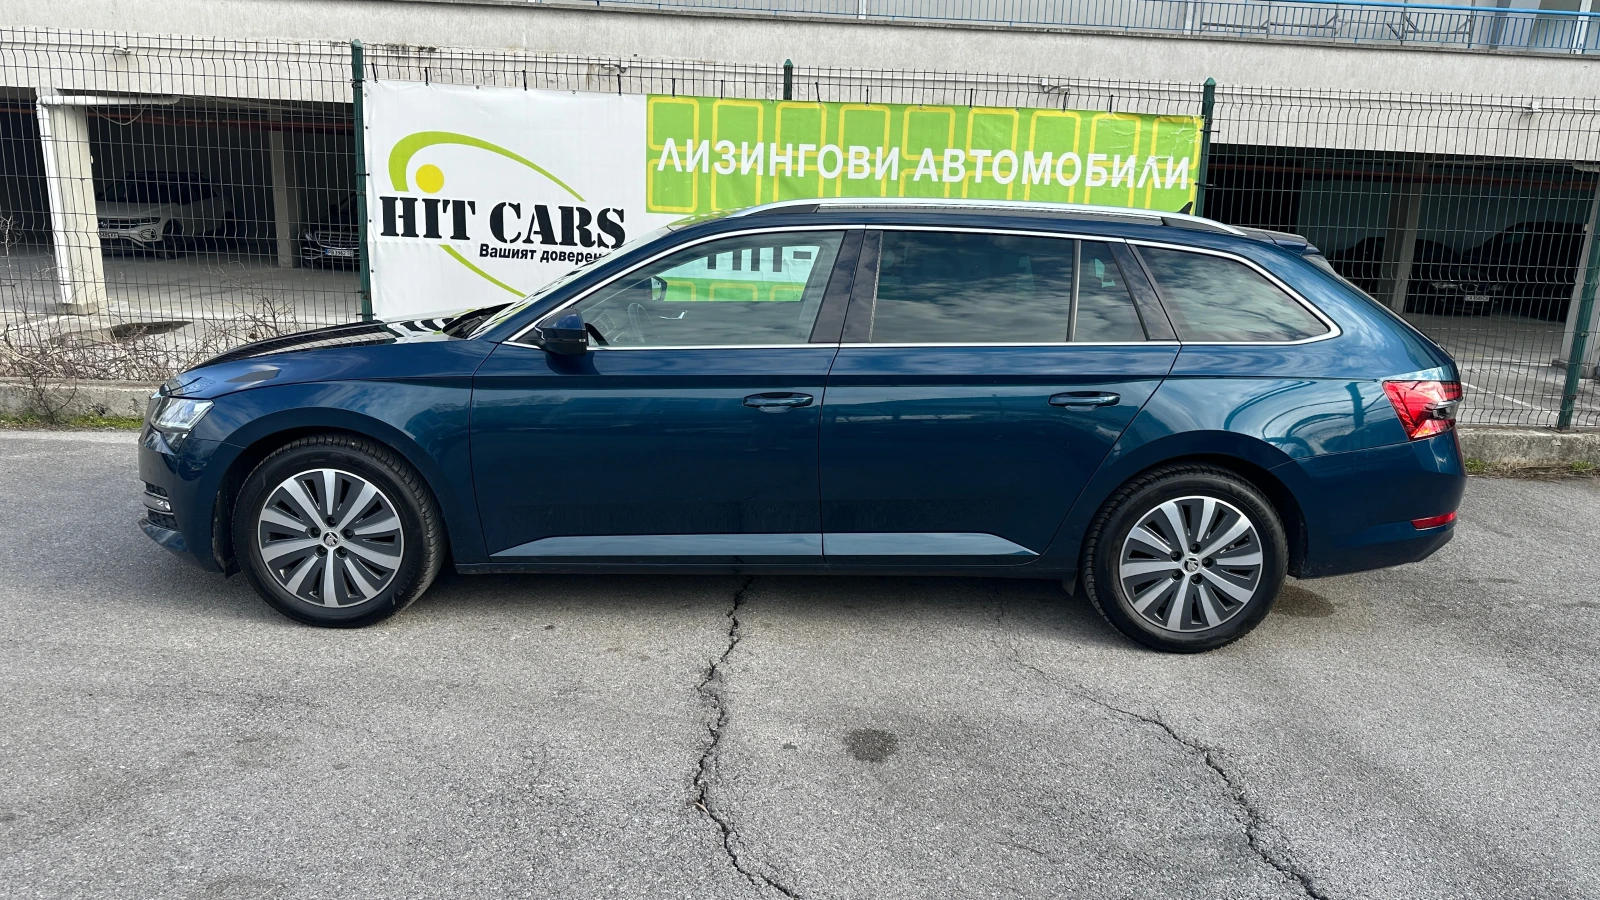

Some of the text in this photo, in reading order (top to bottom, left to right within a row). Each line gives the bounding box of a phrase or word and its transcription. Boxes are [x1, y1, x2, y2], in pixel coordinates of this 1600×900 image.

[657, 138, 1190, 190] ЛИЗИНГОВИ АВТОМОБИЛИ
[379, 196, 627, 249] HIT CARS
[480, 243, 537, 260] Вашият
